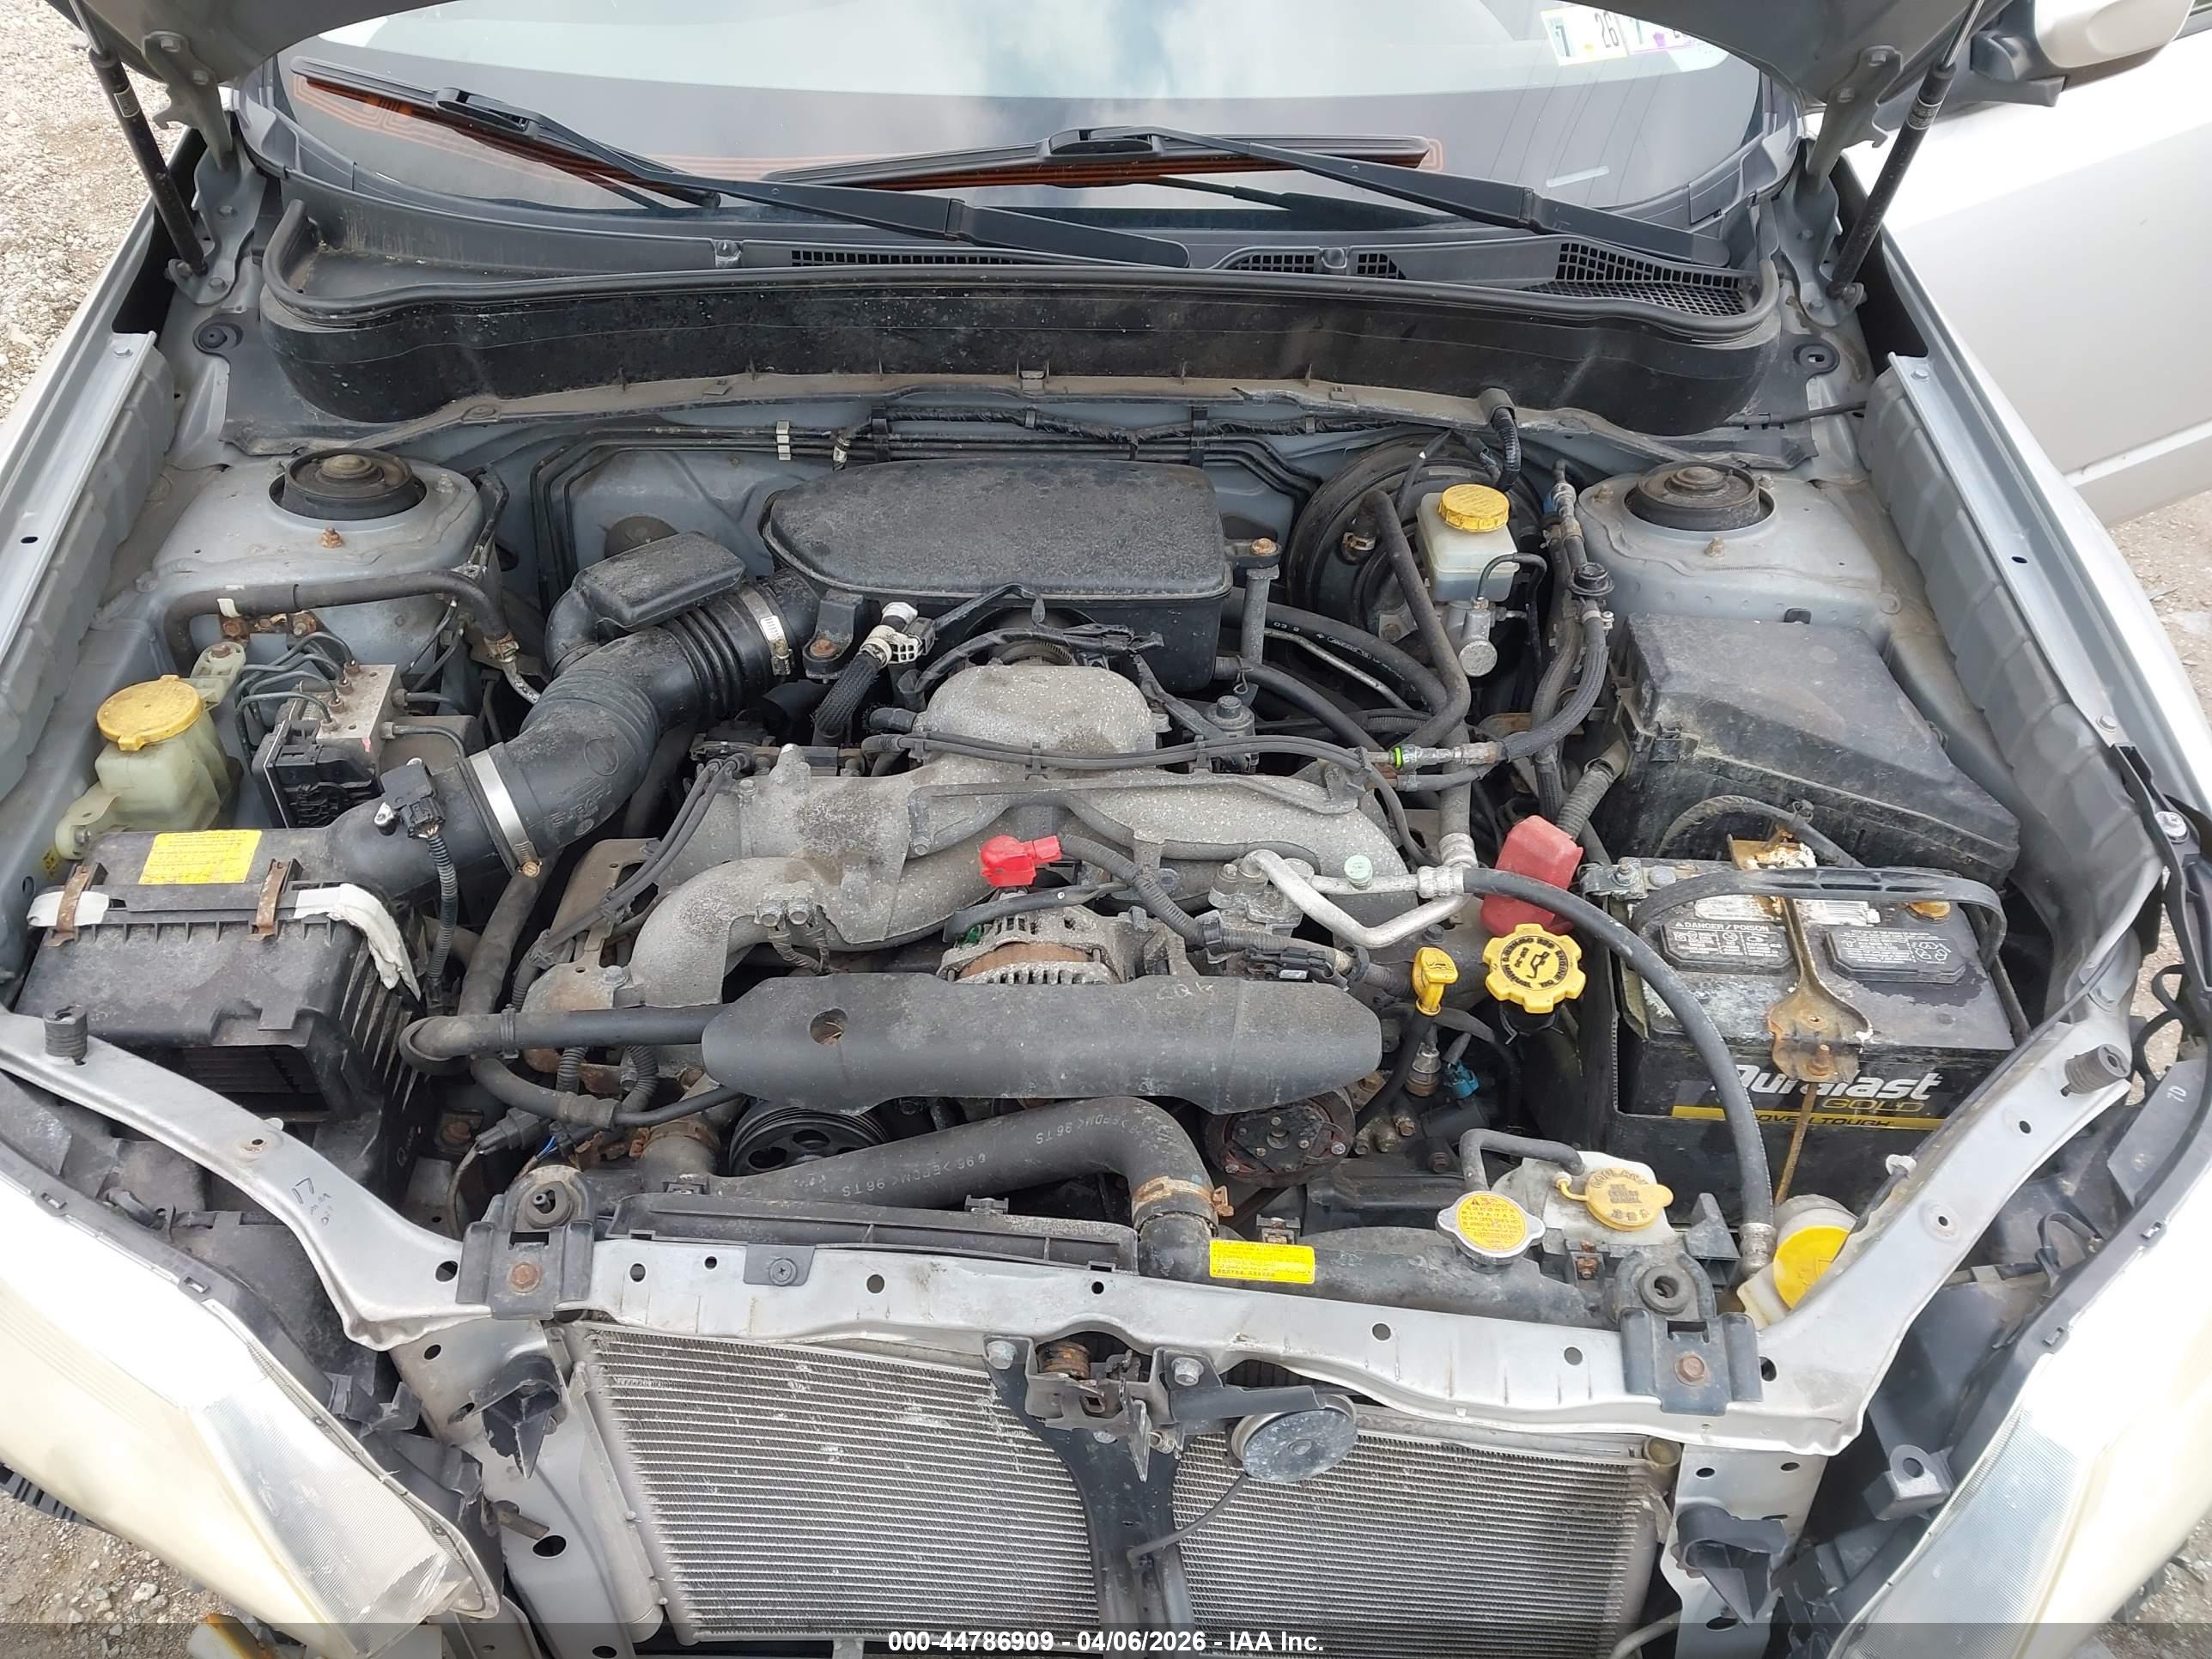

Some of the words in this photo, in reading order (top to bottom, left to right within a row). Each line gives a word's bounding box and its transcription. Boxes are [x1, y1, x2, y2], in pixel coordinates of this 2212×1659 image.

[1595, 11, 1620, 49] 26
[1684, 921, 1724, 930] DANGER
[1822, 1097, 1924, 1113] GOLD
